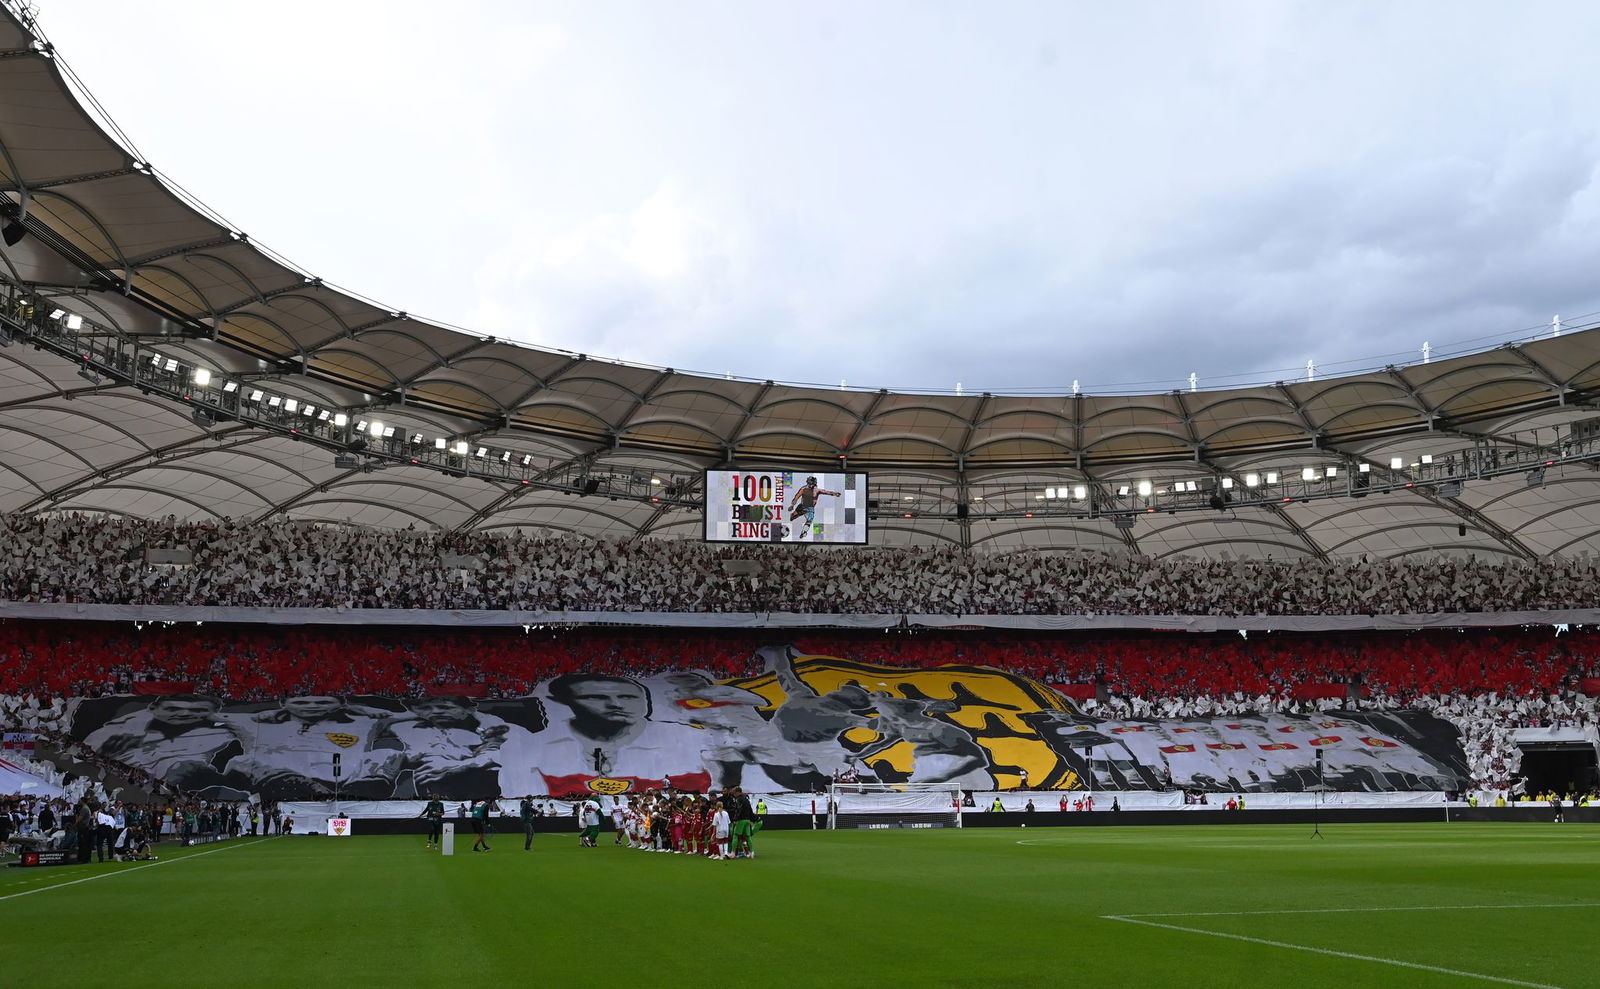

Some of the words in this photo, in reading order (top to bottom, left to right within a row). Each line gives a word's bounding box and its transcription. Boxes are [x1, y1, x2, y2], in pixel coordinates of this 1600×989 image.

[732, 475, 772, 502] 100
[775, 475, 784, 502] JAHRE
[732, 522, 769, 538] RING
